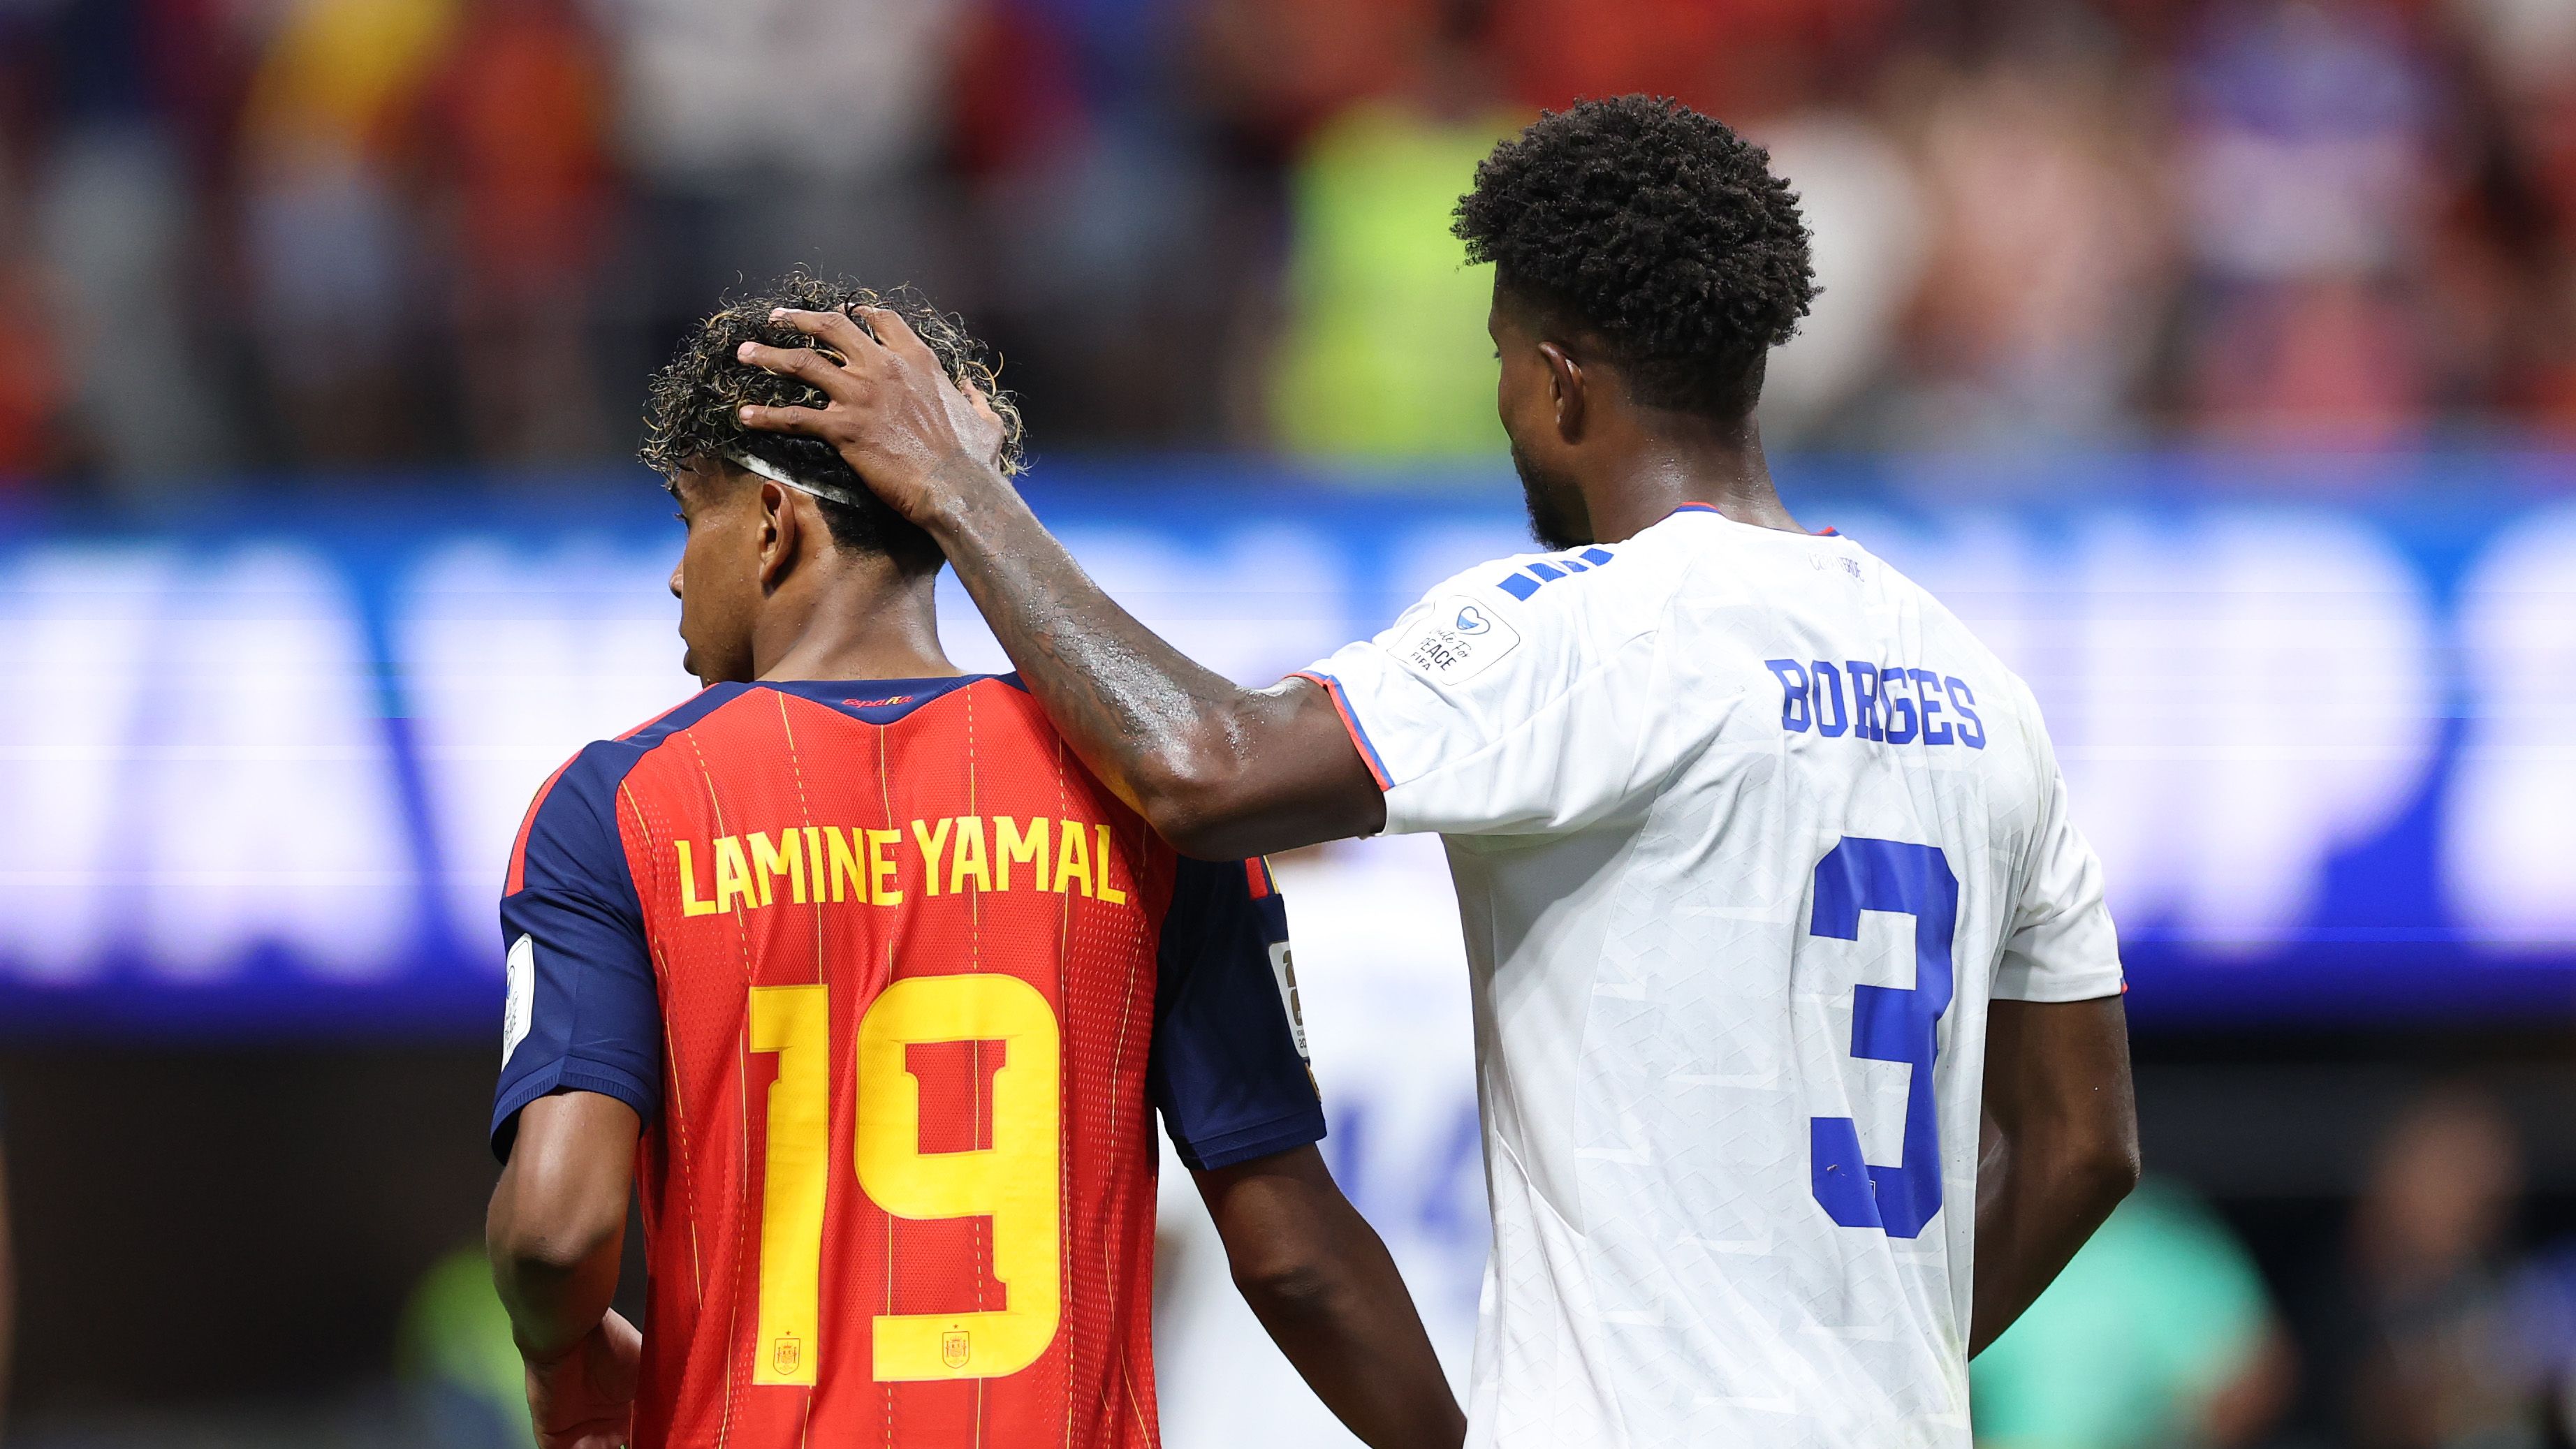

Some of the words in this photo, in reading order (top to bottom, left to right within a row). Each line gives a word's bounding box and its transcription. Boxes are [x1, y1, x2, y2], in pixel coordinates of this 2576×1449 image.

[841, 696, 914, 709] España
[1409, 651, 1431, 671] FIFA
[1765, 658, 1986, 750] BORGES
[674, 824, 904, 918] LAMINE
[912, 815, 1126, 906] YAMAL
[1810, 835, 1959, 1240] 3
[748, 973, 1060, 1387] 19
